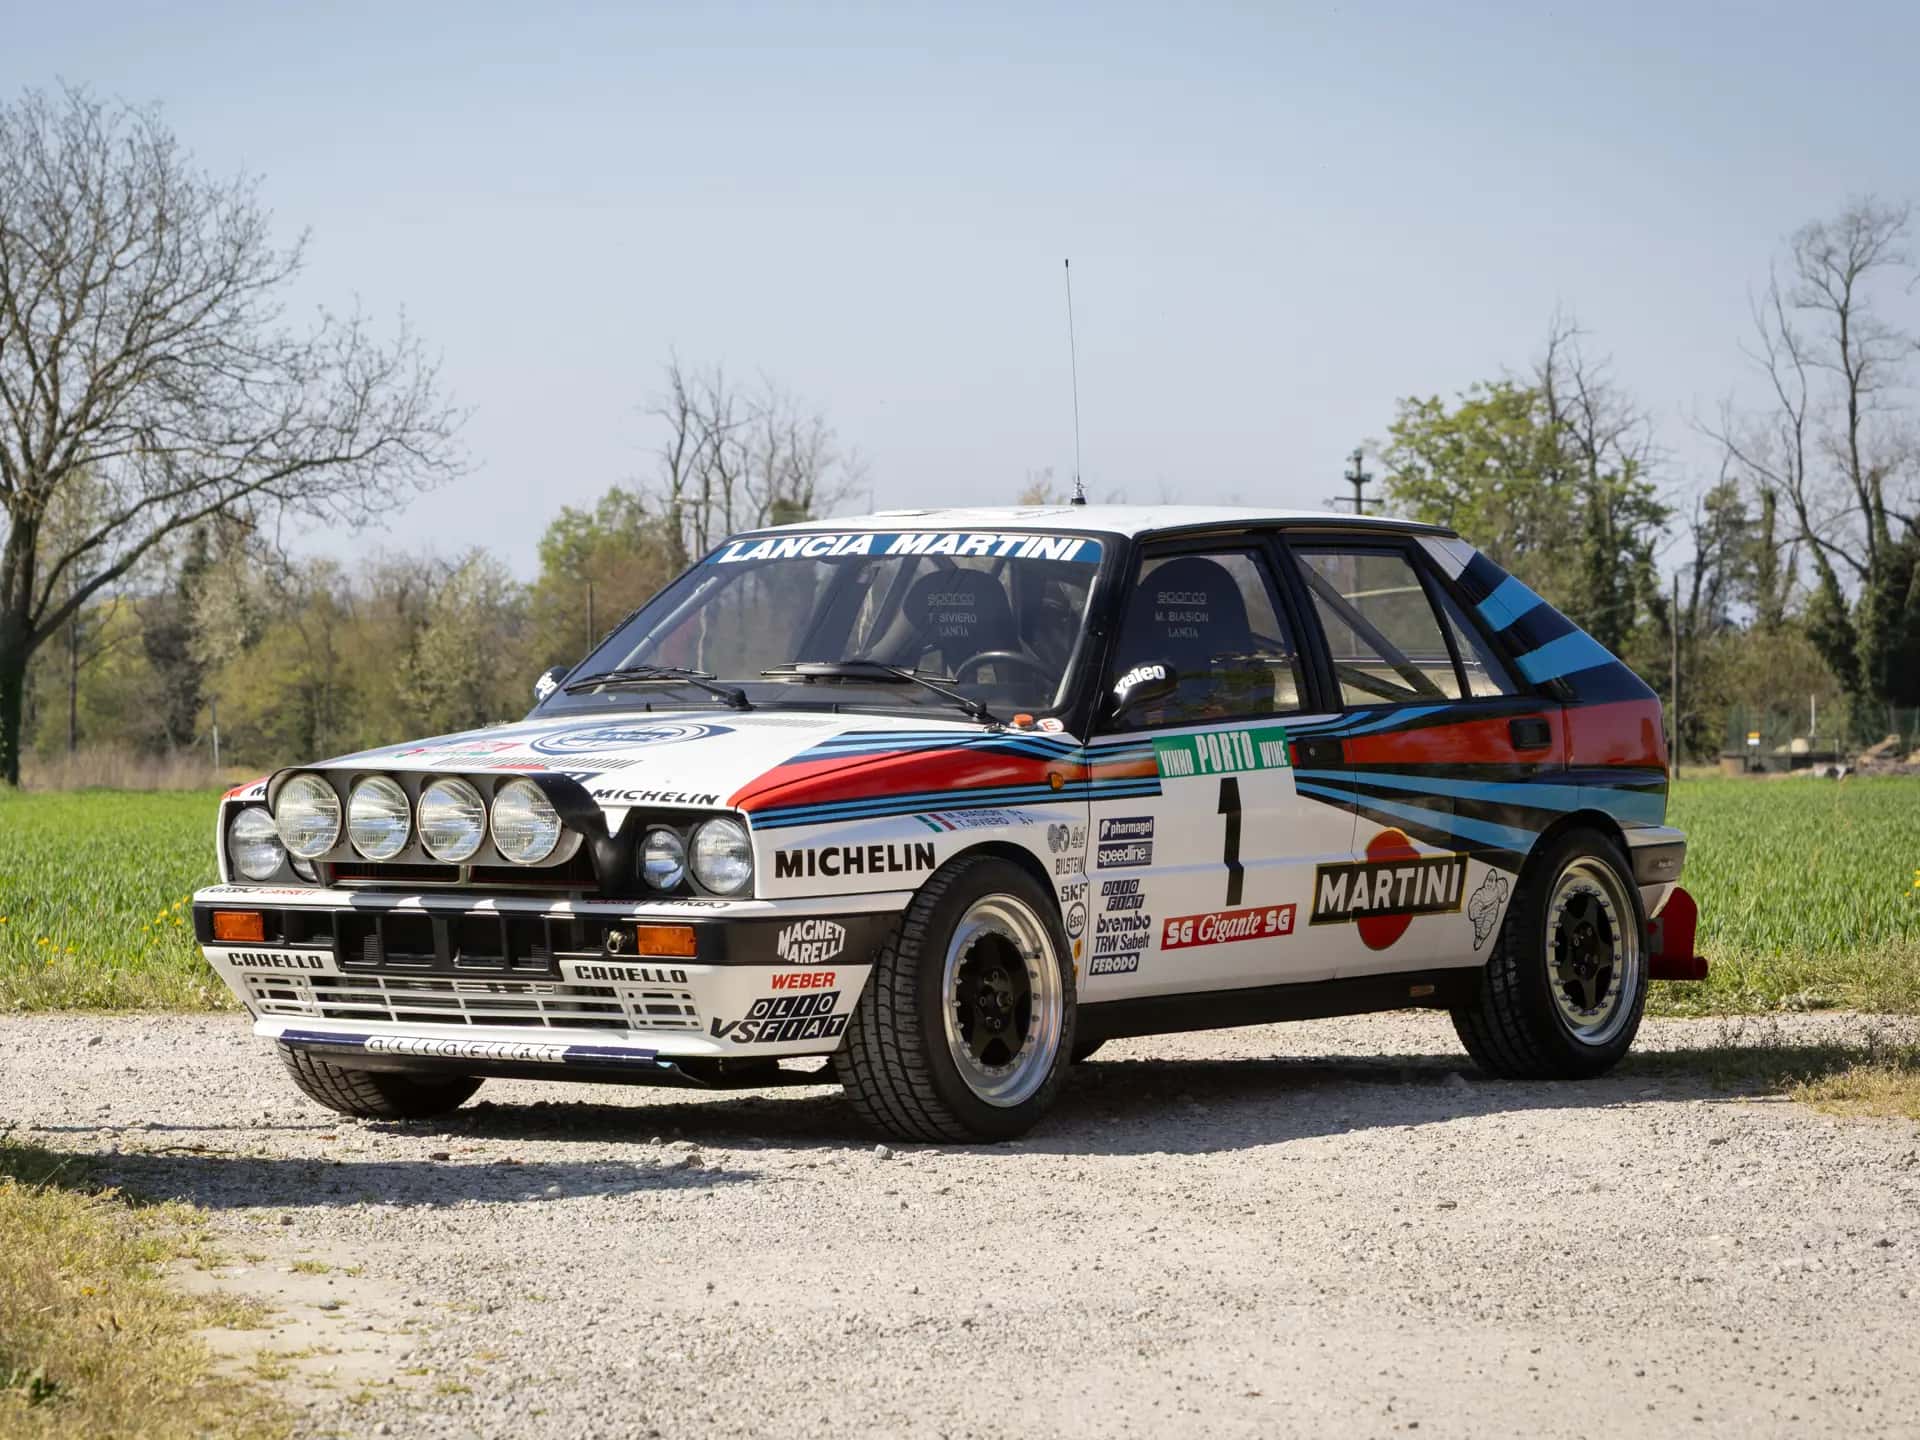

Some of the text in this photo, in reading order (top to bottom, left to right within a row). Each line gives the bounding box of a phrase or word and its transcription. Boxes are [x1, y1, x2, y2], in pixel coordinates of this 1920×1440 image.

[718, 534, 1085, 563] LANCIA MARTINI
[1113, 665, 1166, 698] valeo
[1160, 731, 1288, 776] VINHO PORTO WINE
[592, 789, 720, 805] MICHELIN
[1111, 819, 1153, 838] pharmagel
[1217, 777, 1244, 906] 1
[774, 842, 937, 878] MICHELIN
[1056, 856, 1084, 876] BILSTEIN
[1099, 845, 1146, 866] speedline
[1061, 882, 1088, 902] SKF
[1103, 880, 1138, 895] OLIO
[1318, 864, 1461, 914] MARTINI
[1108, 895, 1144, 910] FIAT
[777, 920, 846, 946] MAGNETI
[1096, 911, 1151, 933] brembo
[1167, 908, 1290, 945] SG Gigante SG
[777, 939, 846, 964] MARELLI
[1095, 931, 1150, 953] TRW Sabelt
[228, 953, 324, 969] CARELLO
[1091, 955, 1137, 974] FERODO
[574, 965, 688, 983] CARELLO
[771, 972, 836, 989] WEBER
[750, 994, 837, 1018] OLIO
[758, 1016, 847, 1041] FIAT
